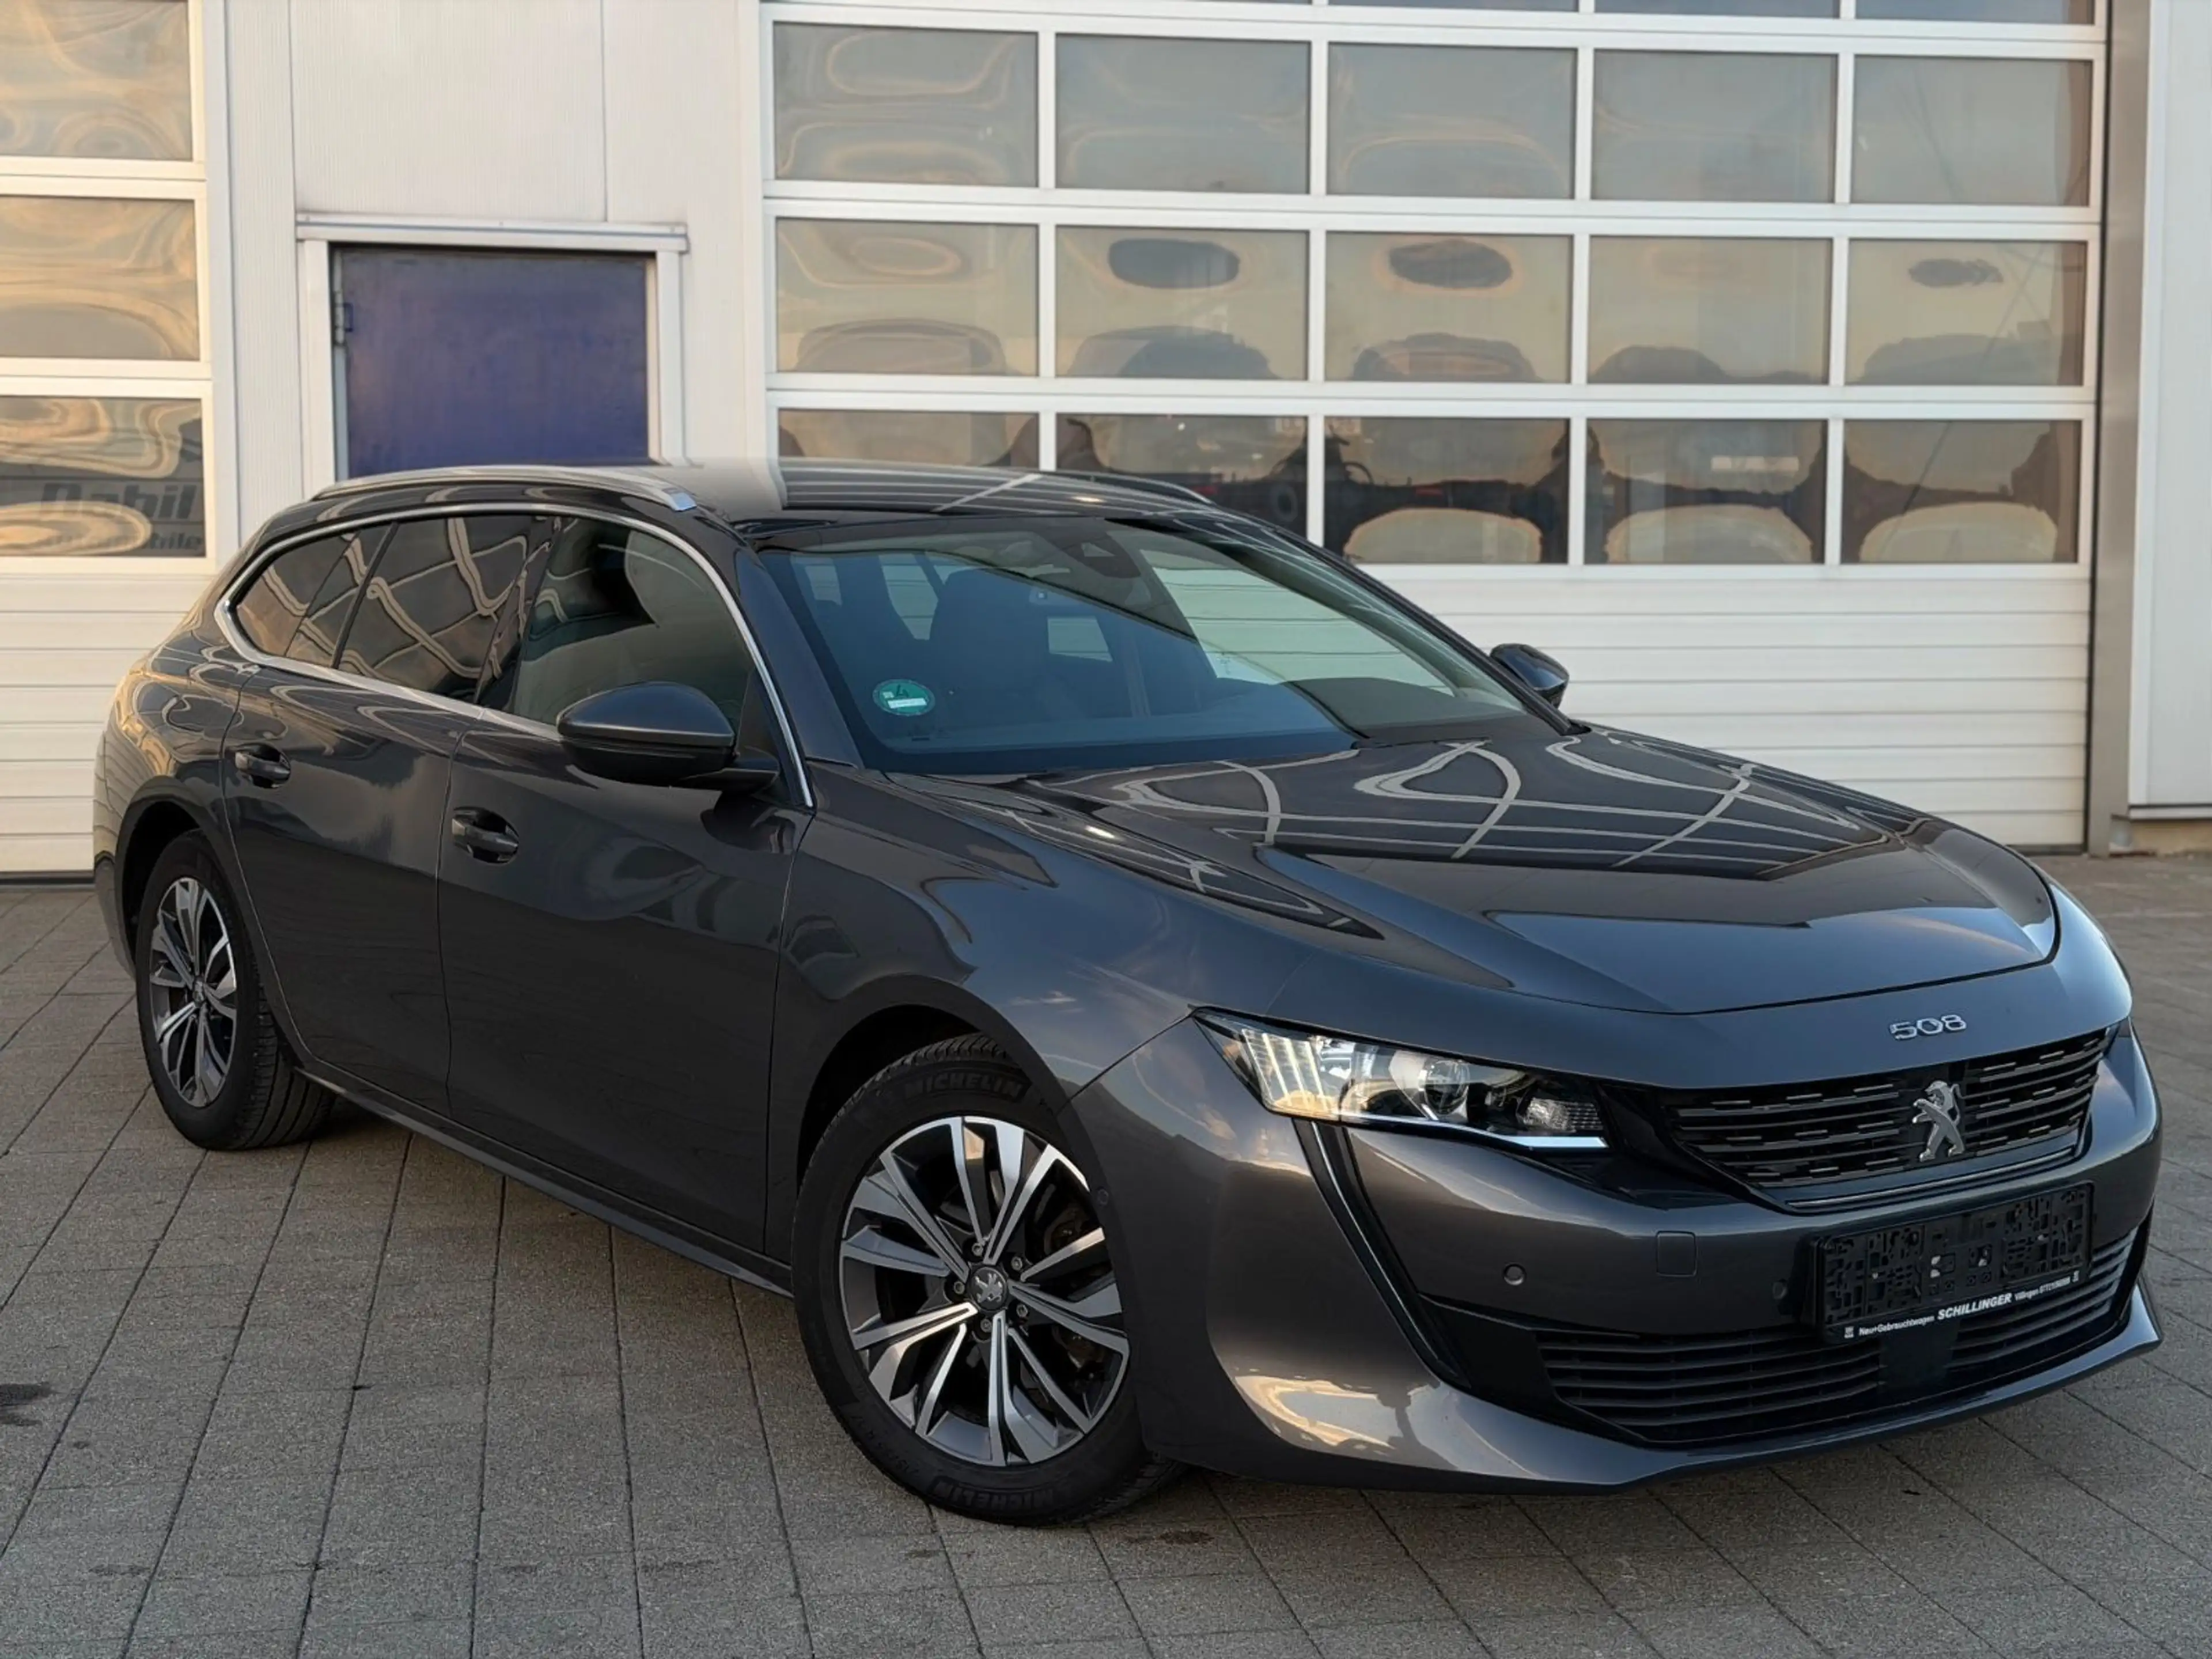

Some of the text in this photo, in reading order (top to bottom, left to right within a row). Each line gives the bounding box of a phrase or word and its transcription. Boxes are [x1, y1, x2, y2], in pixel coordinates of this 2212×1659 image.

[1889, 1014, 1967, 1040] 508
[904, 1071, 1023, 1099] MICHELIN
[1937, 1292, 2013, 1320] SCHILLINGER
[933, 1479, 1054, 1510] MICHELIN
